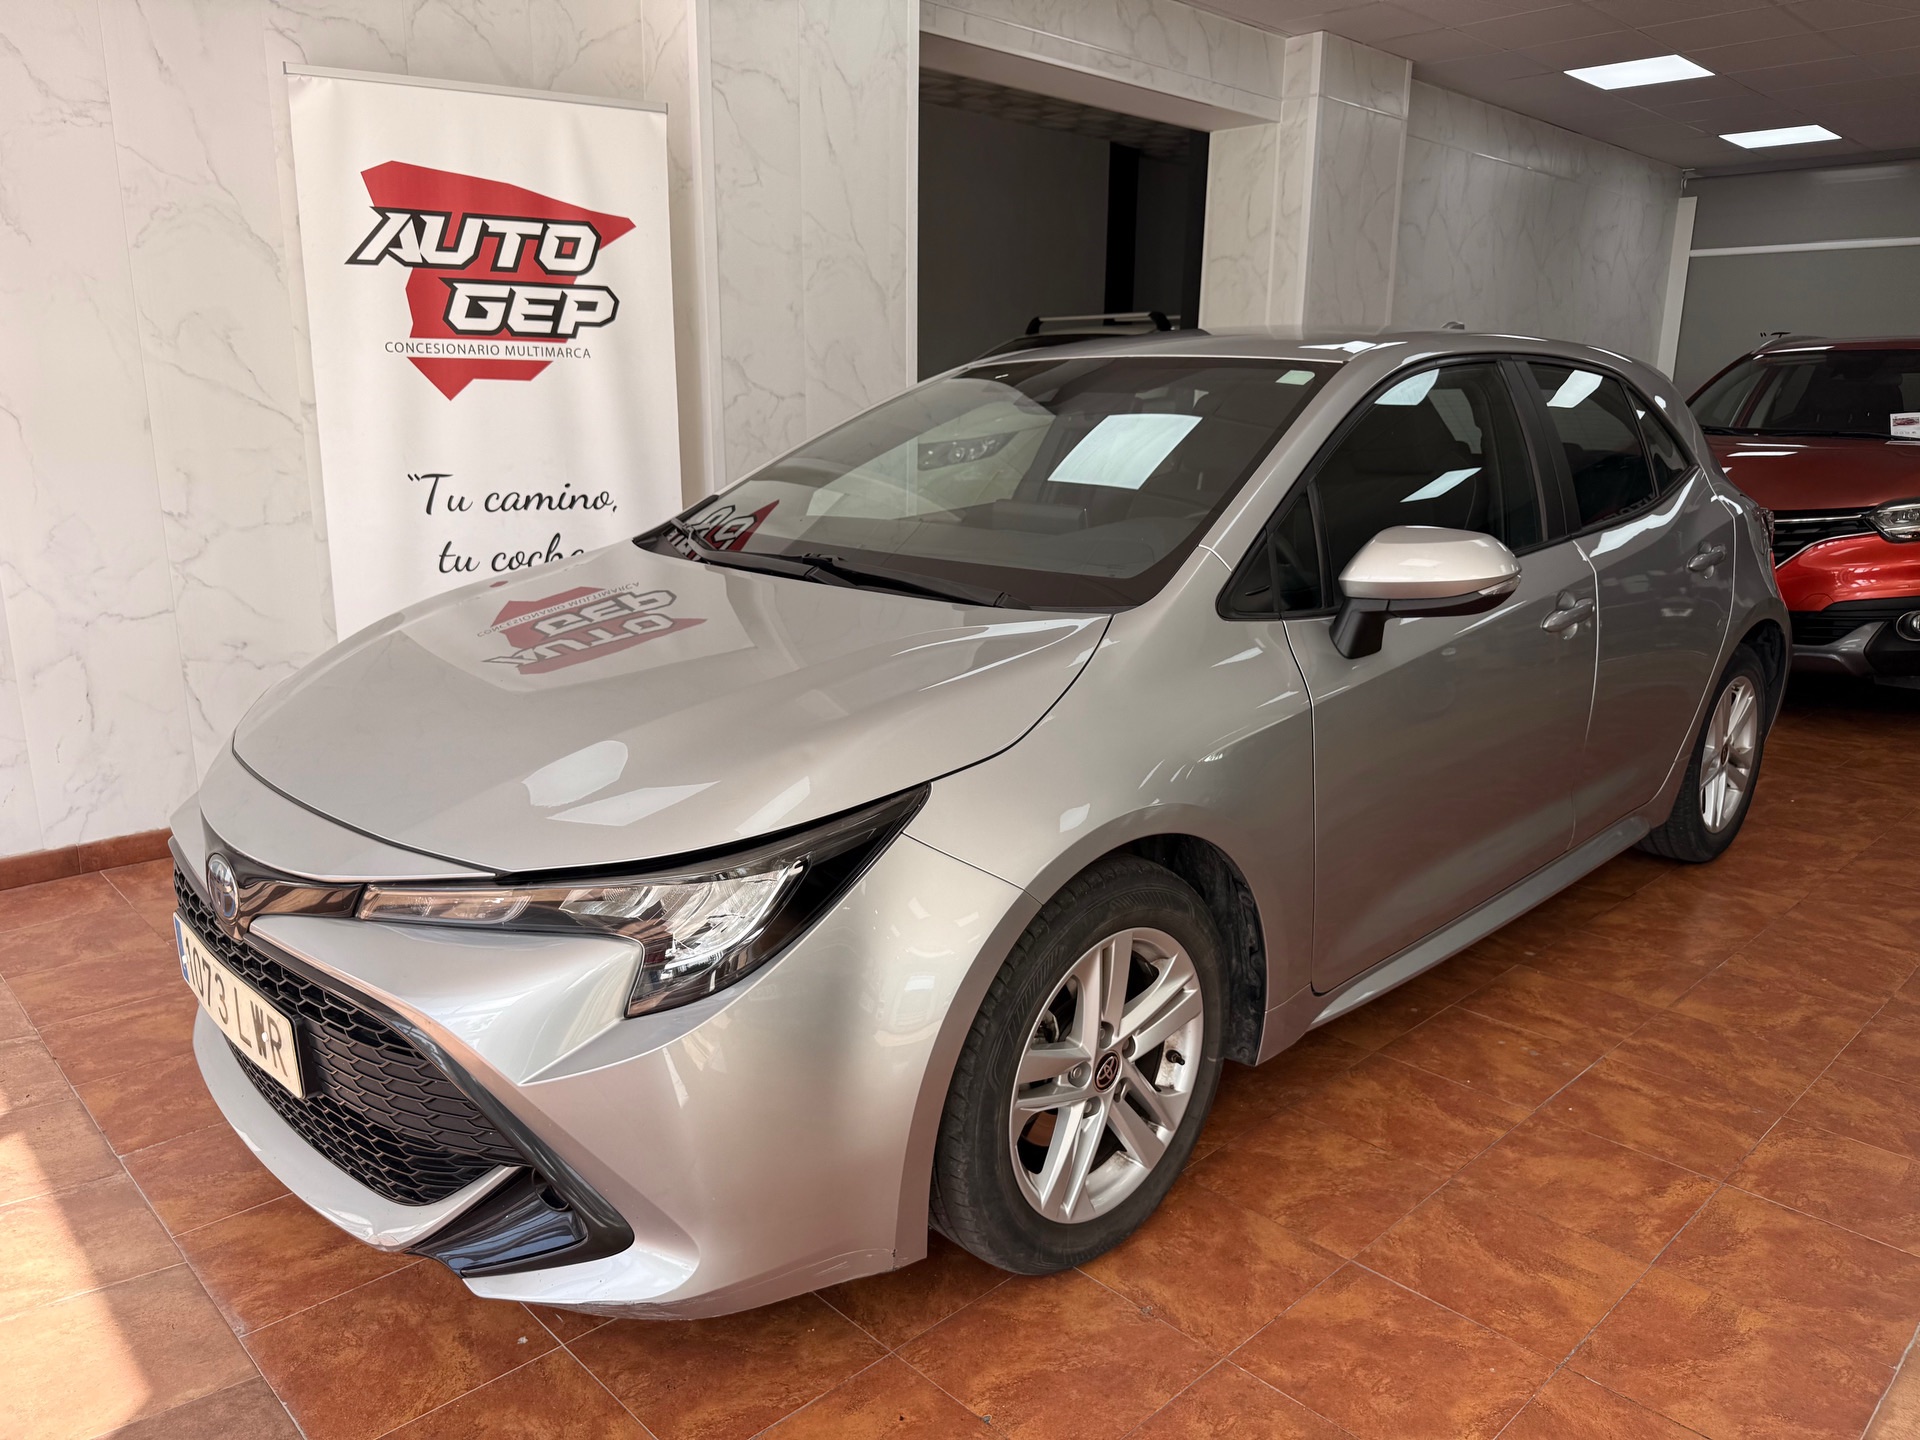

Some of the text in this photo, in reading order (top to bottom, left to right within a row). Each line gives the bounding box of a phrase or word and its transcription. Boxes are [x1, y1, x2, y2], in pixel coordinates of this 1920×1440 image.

[345, 206, 602, 275] AUTO
[438, 277, 619, 338] GEP
[384, 341, 592, 359] CONCESIONARIO MULTIMARCA
[484, 483, 618, 513] camino,
[438, 540, 481, 573] tu
[185, 936, 288, 1078] 1073 LWR
